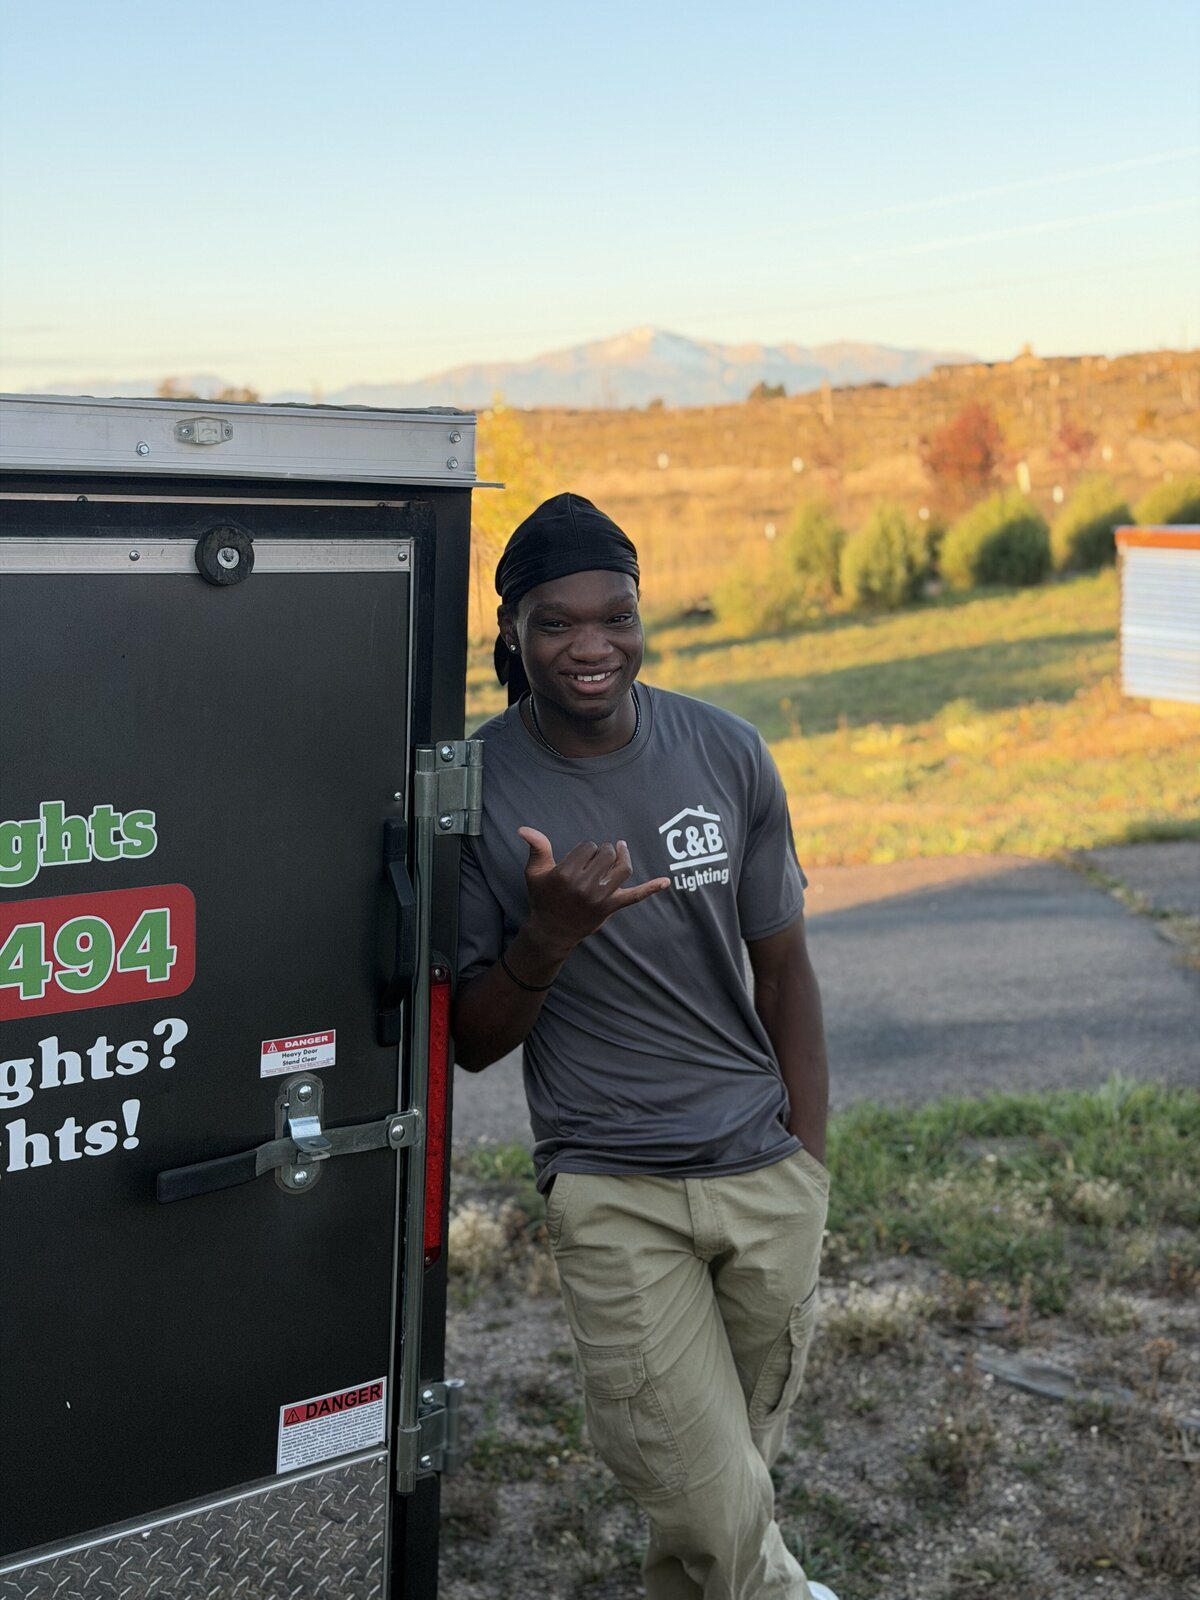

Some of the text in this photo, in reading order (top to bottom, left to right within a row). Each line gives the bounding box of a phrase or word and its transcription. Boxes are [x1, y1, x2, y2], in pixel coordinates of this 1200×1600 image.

[666, 822, 723, 860] C&B
[674, 867, 729, 892] Lighting
[284, 1035, 329, 1048] DANGER
[281, 1050, 302, 1059] Heavy
[282, 1056, 318, 1066] Stand Clear
[0, 1098, 141, 1178] hts!
[305, 1384, 382, 1419] DANGER
